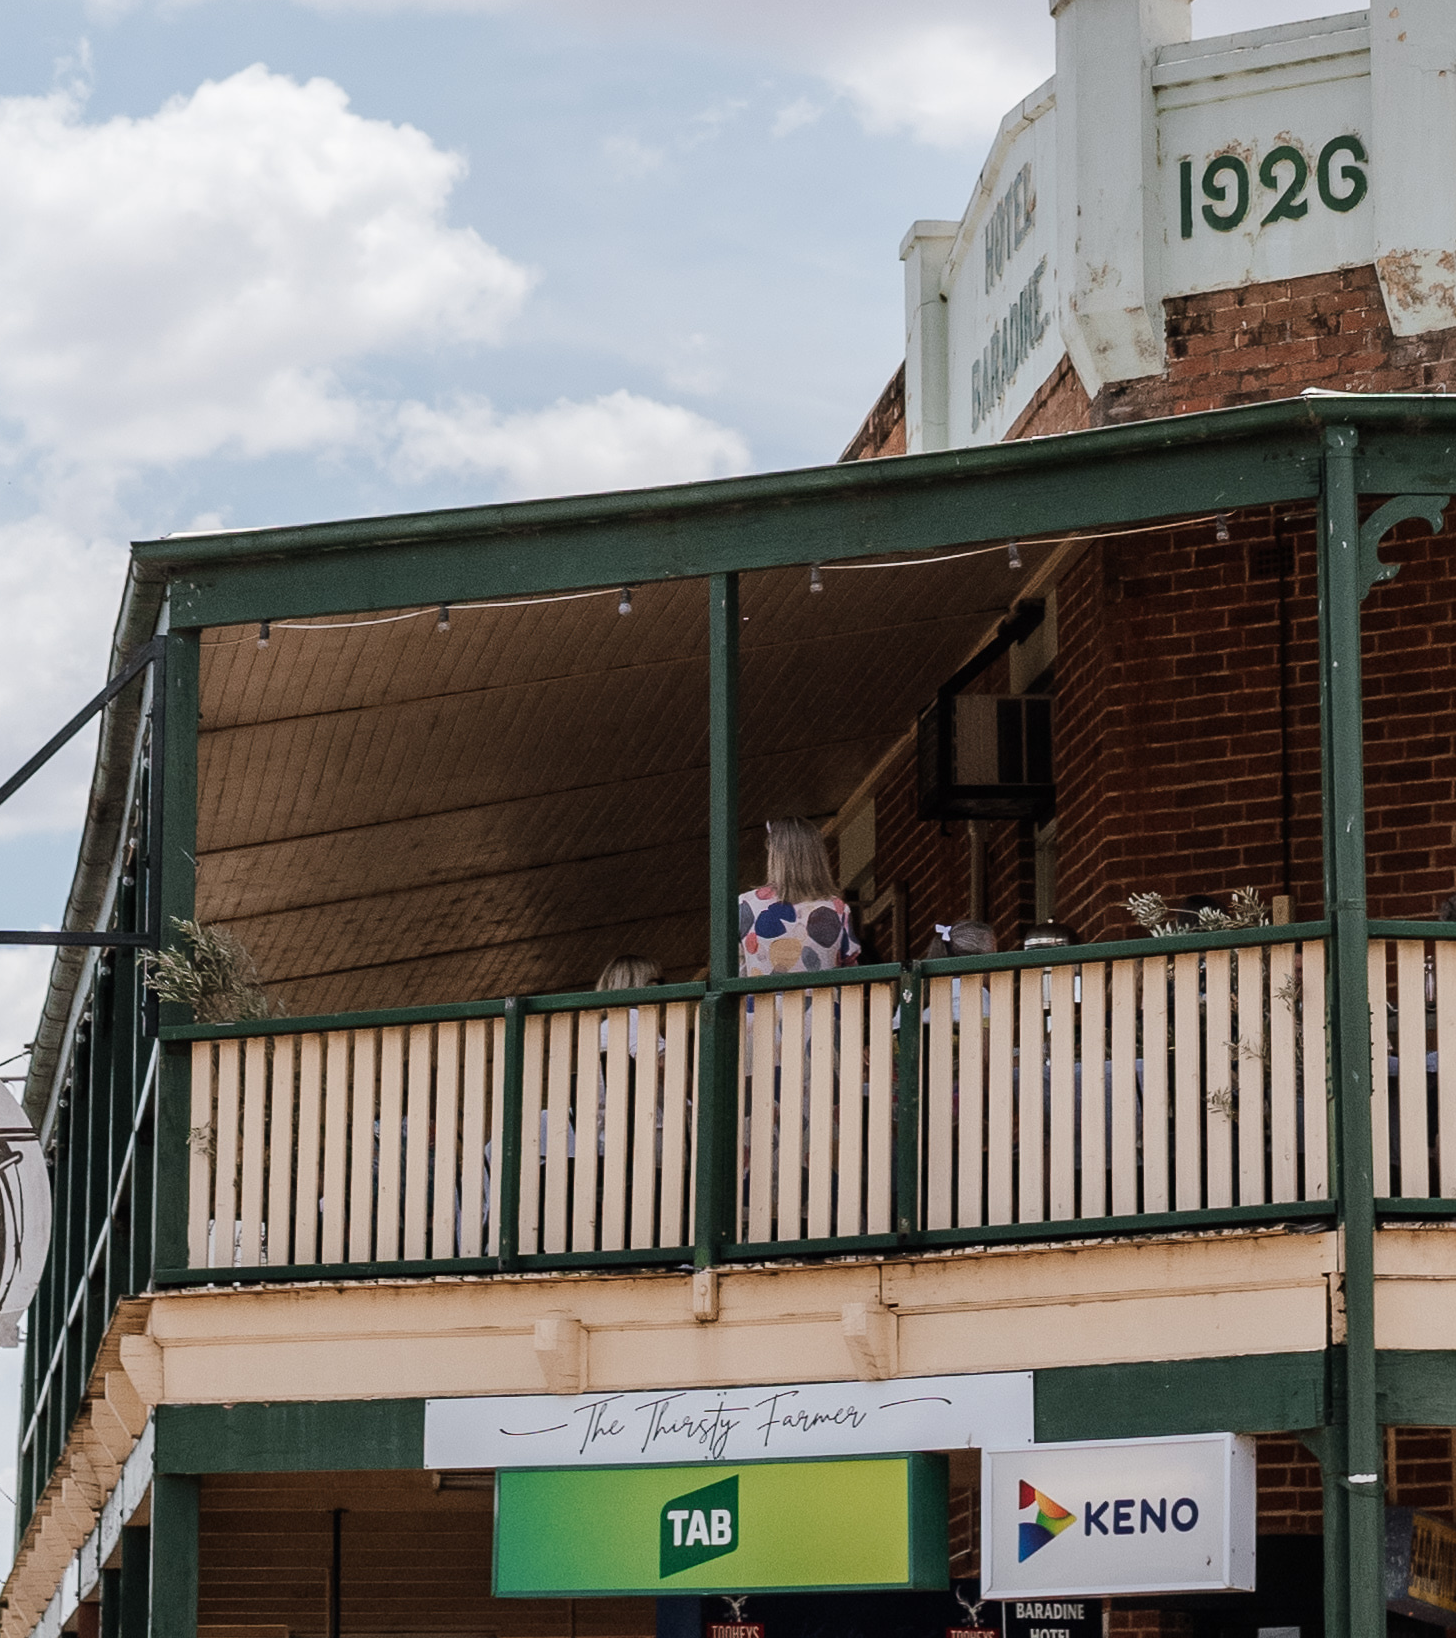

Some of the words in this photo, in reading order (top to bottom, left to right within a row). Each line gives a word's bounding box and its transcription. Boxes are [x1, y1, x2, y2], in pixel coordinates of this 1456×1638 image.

[1179, 134, 1368, 239] 1926
[984, 162, 1036, 295] HOTEL
[574, 1394, 625, 1454] The
[636, 1392, 750, 1460] Thirsty
[755, 1390, 867, 1447] Farmer
[666, 1508, 733, 1548] TAB
[1083, 1496, 1201, 1537] KENO
[1015, 1602, 1086, 1621] BARADINE
